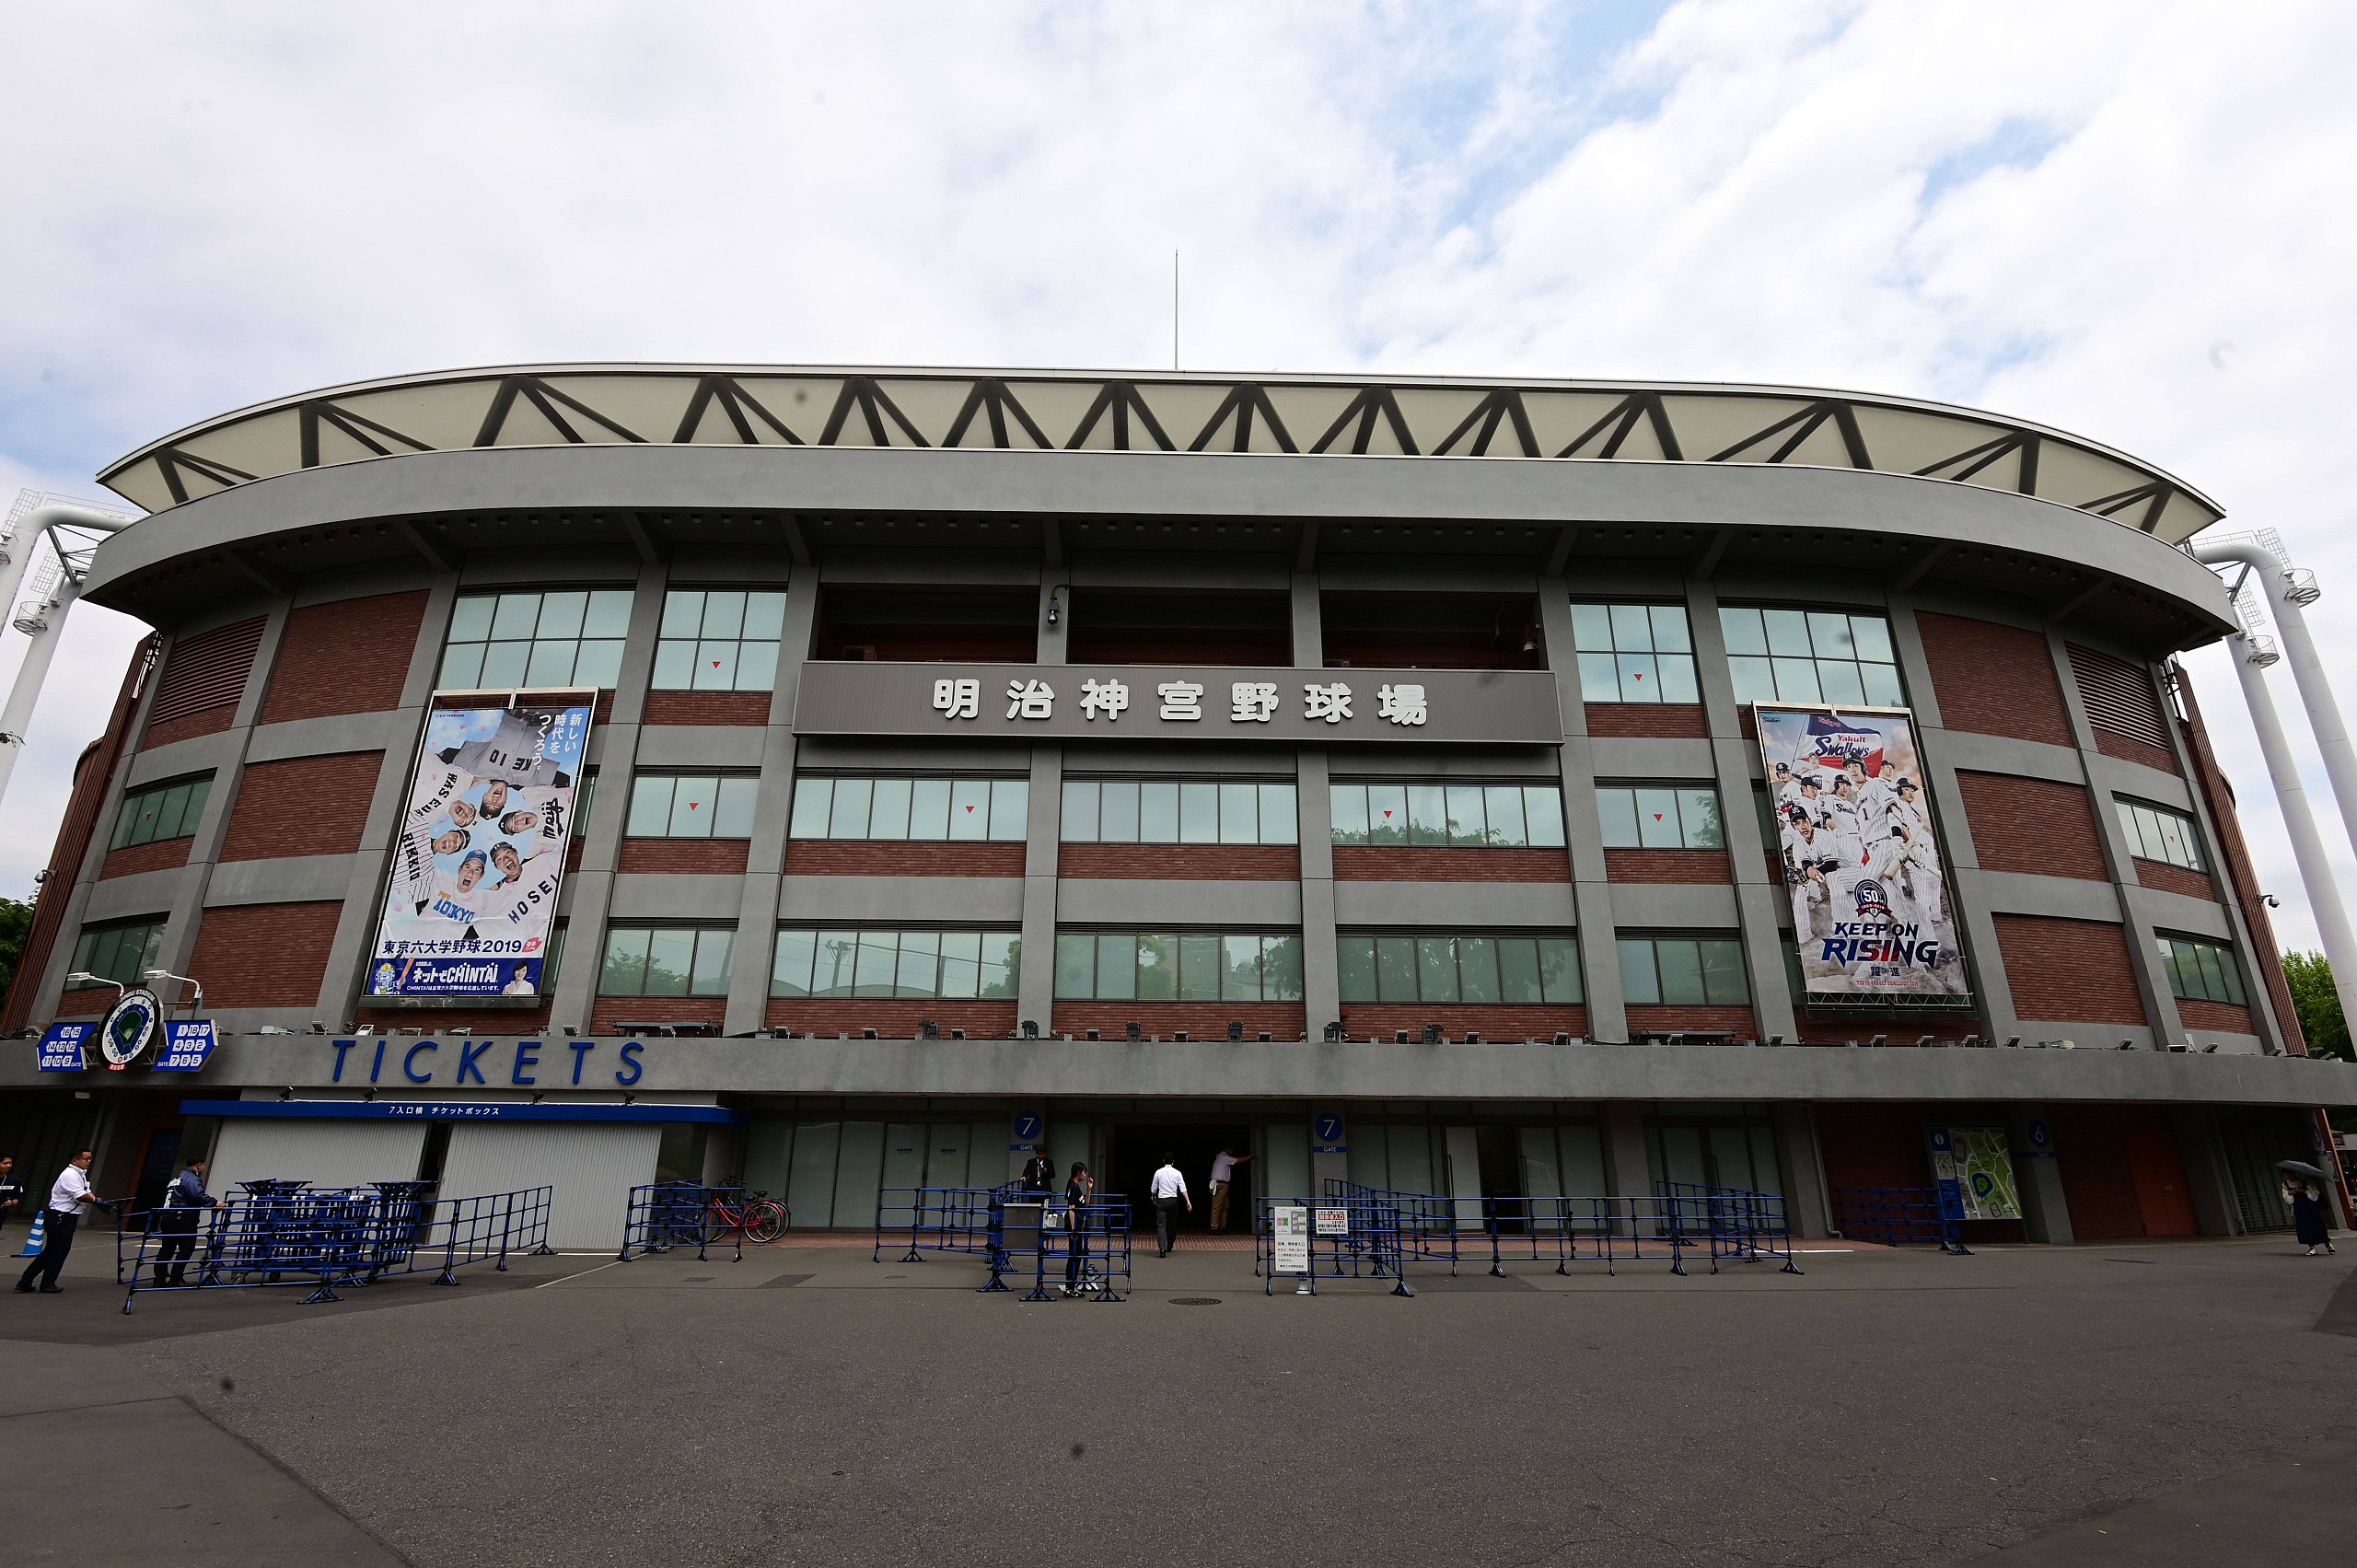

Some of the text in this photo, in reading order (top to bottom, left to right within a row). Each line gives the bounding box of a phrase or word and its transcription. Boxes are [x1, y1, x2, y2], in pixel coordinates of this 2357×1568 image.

[933, 678, 1429, 726] 明治神宮野球場
[550, 714, 566, 754] 時代を
[564, 714, 583, 752] 新しい
[1838, 735, 1866, 743] Yakult
[531, 714, 552, 771] つくろう。
[1815, 737, 1870, 757] Swallows
[1863, 889, 1878, 902] 50
[433, 892, 475, 923] TOKYO
[1834, 921, 1919, 940] KEEP ON
[382, 939, 522, 954] 東京六大学野球2019
[1821, 936, 1939, 970] RISING
[135, 989, 156, 1002] STADIUM
[47, 1042, 75, 1051] 14 13 12
[44, 1057, 52, 1065] 11
[53, 1057, 62, 1065] 10
[331, 1040, 644, 1086] TICKETS
[389, 1107, 424, 1115] 7入口横
[1023, 1117, 1035, 1135] 7
[1324, 1119, 1335, 1137] 7
[2035, 1125, 2044, 1142] 6
